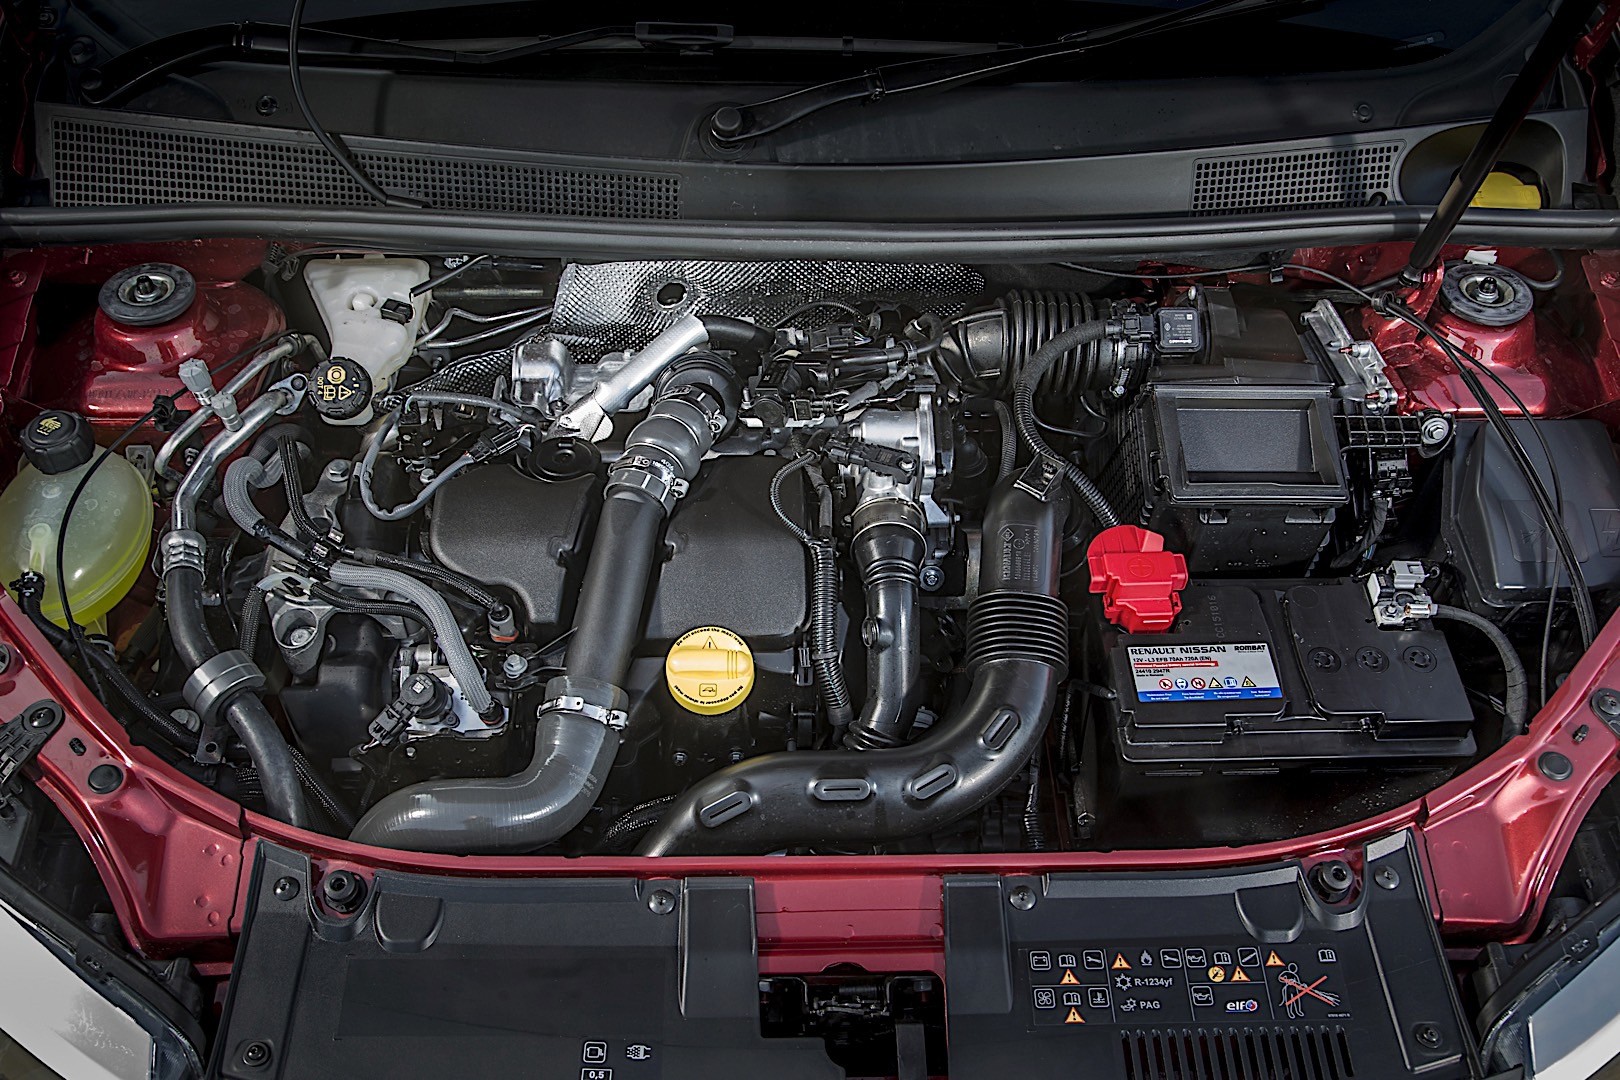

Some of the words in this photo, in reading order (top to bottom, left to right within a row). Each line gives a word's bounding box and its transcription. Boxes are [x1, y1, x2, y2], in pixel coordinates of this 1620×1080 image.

[734, 636, 744, 646] level
[1130, 647, 1176, 656] RENAULT
[1180, 645, 1227, 654] NISSAN
[1199, 655, 1212, 663] (EN)
[1134, 977, 1173, 987] R-1234yf
[1140, 1000, 1160, 1010] PAG
[1226, 1001, 1245, 1011] elf
[589, 1071, 605, 1080] 0,5
